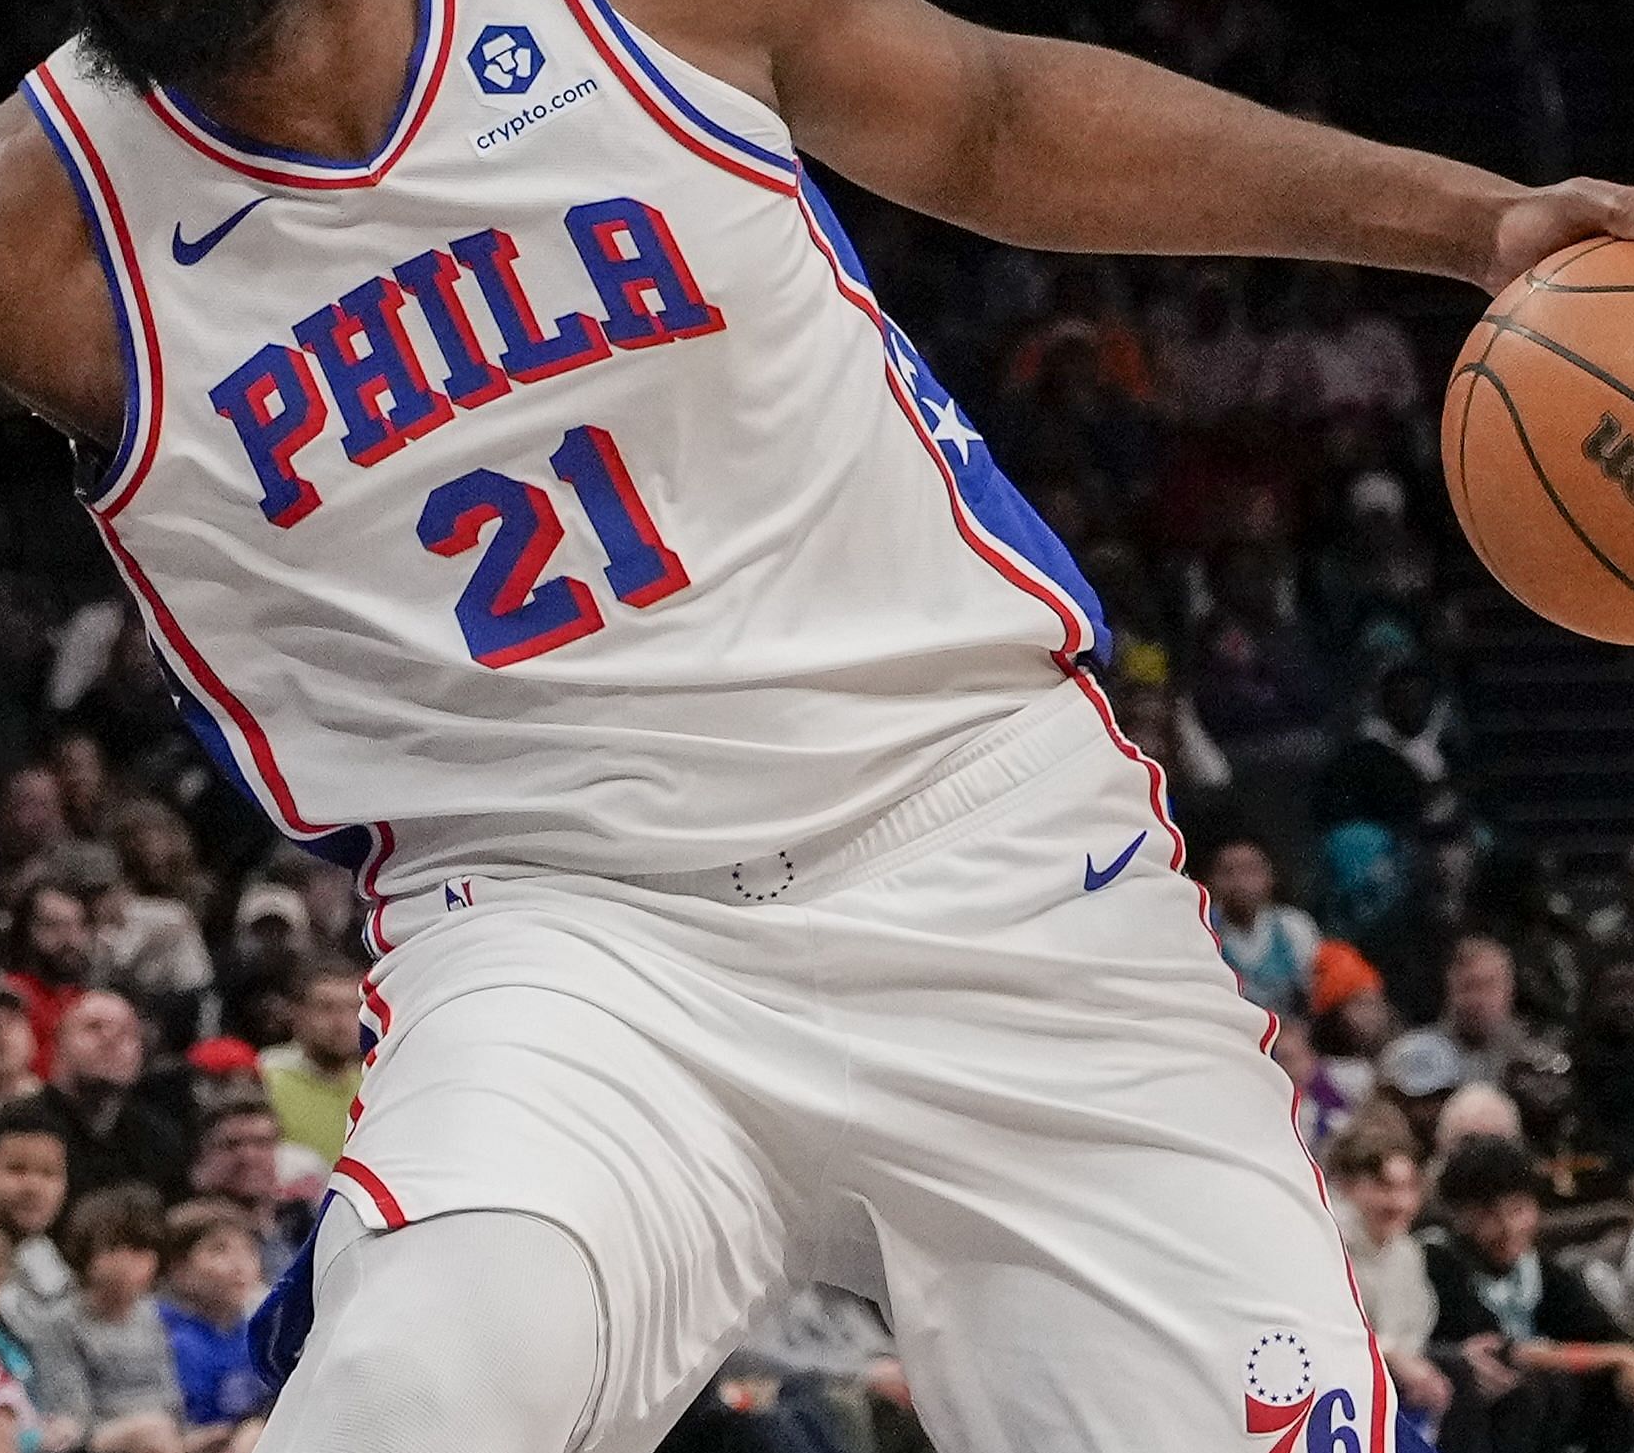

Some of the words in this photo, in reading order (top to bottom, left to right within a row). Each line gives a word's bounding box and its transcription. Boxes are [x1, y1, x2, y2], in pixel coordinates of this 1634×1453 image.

[477, 79, 598, 149] crypto.com
[208, 196, 725, 530] PHILA
[416, 424, 692, 670] 21
